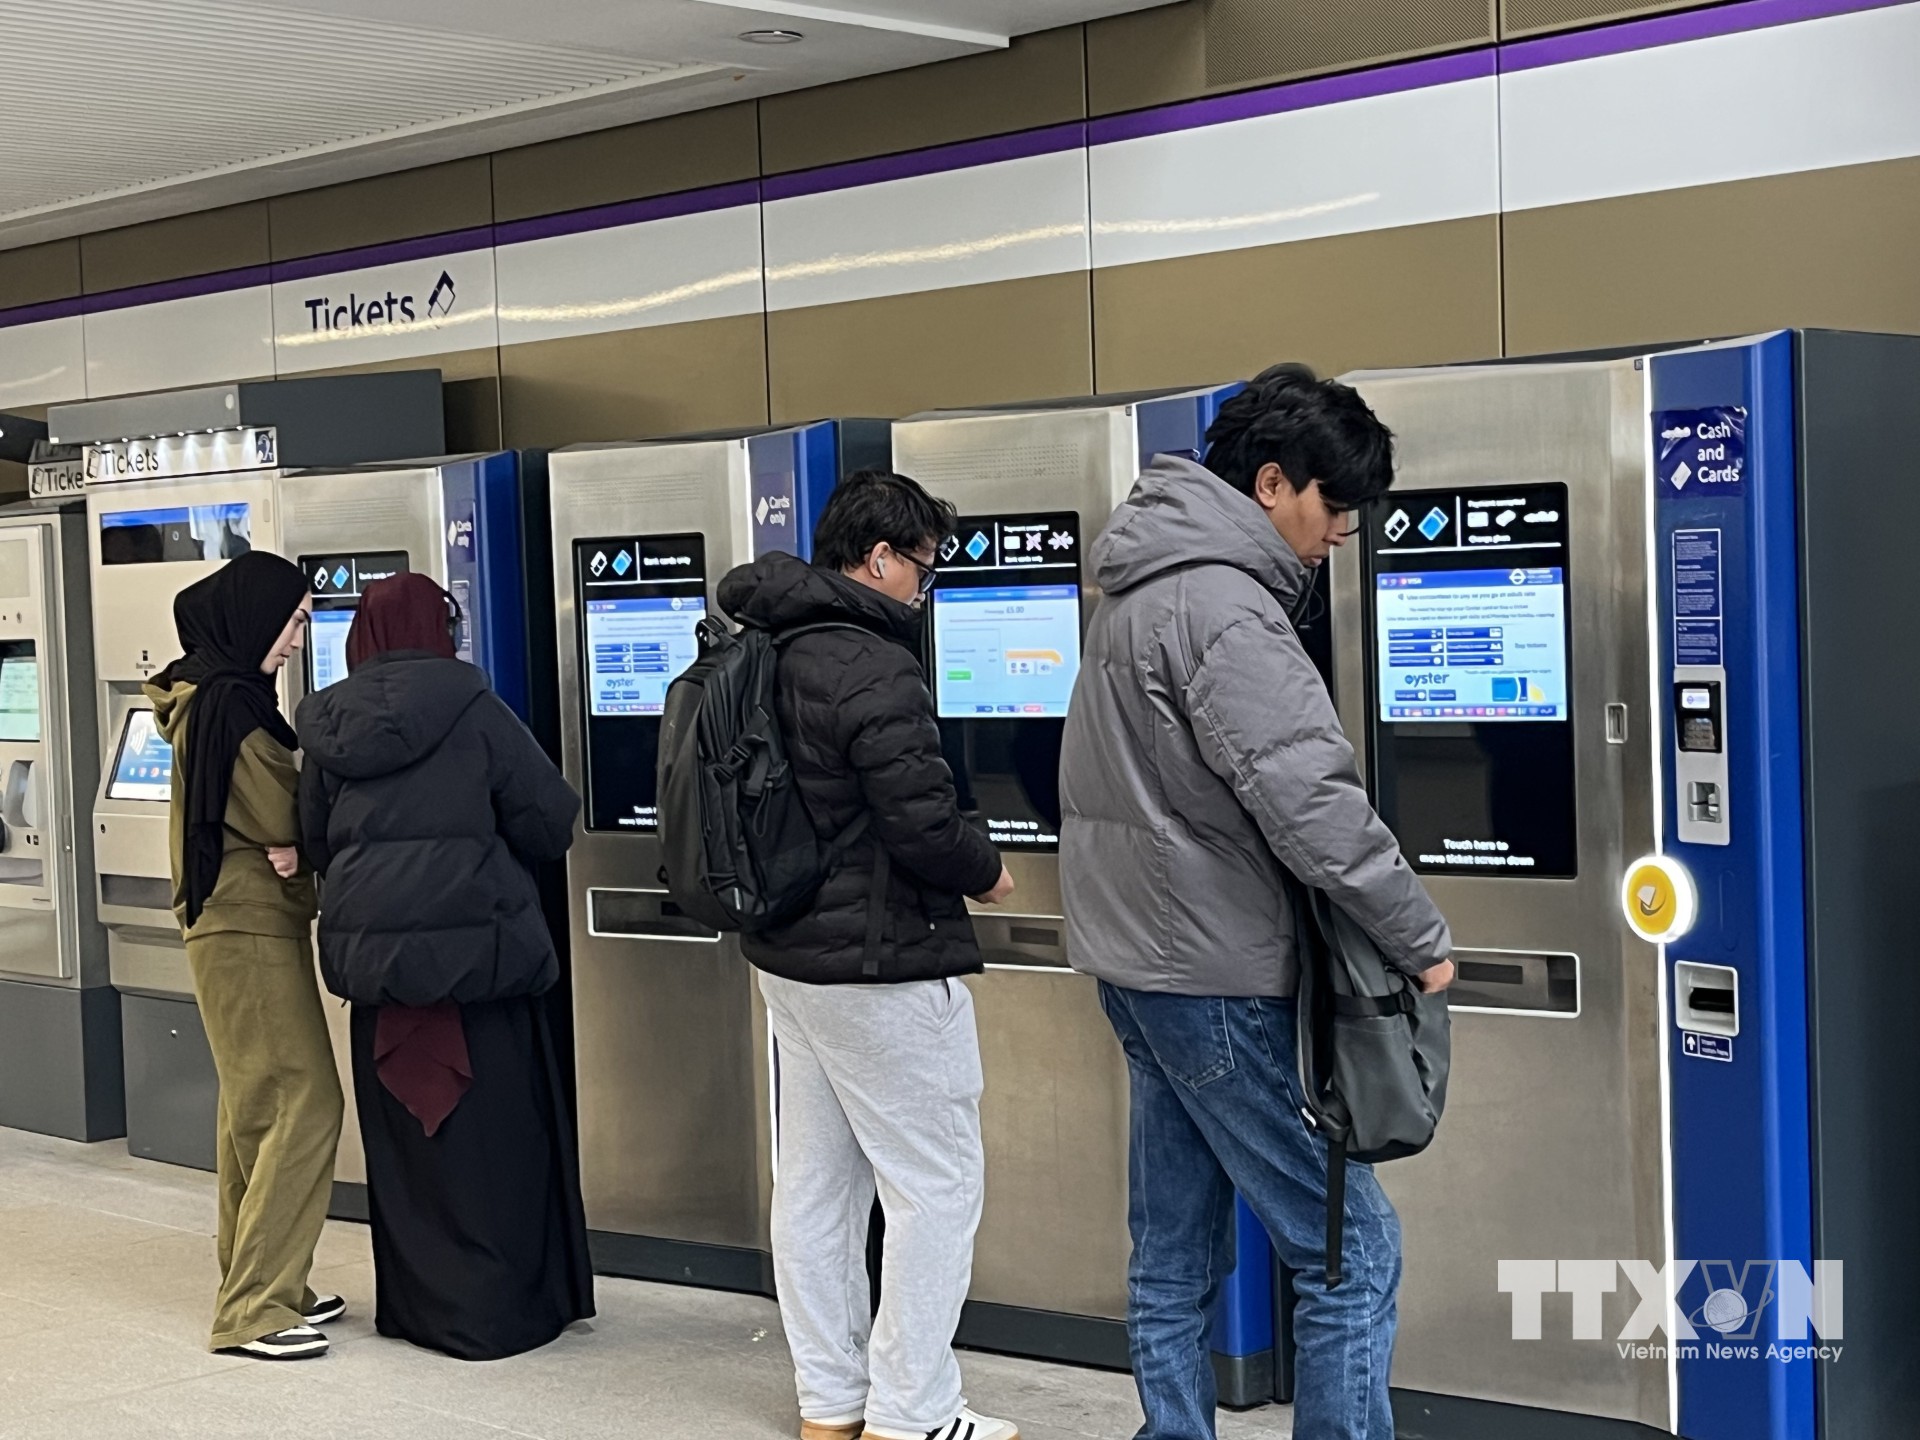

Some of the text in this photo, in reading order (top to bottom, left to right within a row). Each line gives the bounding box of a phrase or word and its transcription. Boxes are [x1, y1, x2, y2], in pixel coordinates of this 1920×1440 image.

[305, 291, 415, 332] Tickets
[1697, 421, 1731, 440] Cash
[1697, 443, 1725, 461] and
[101, 448, 159, 476] Tickets
[44, 468, 83, 492] Ticke
[1697, 465, 1740, 483] Cards
[769, 495, 790, 509] Cards
[769, 510, 786, 527] only
[1404, 672, 1450, 688] oyster
[1443, 838, 1473, 850] Touch
